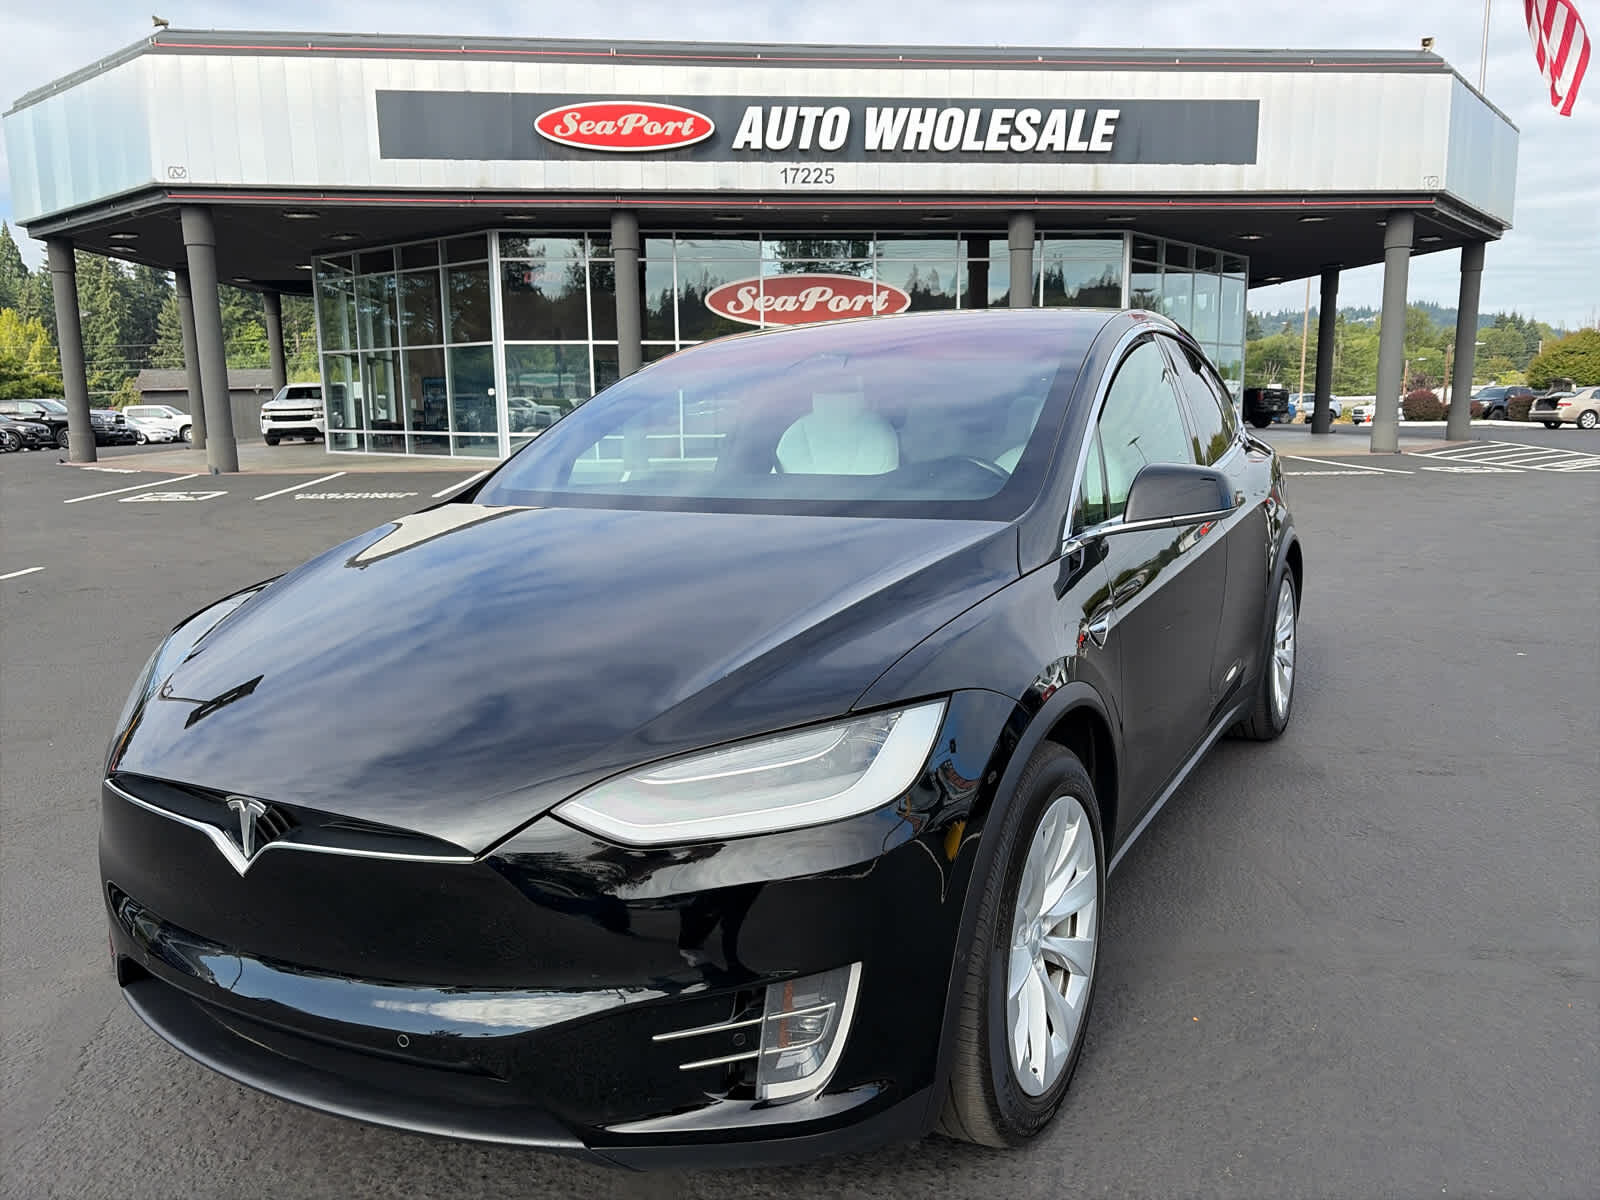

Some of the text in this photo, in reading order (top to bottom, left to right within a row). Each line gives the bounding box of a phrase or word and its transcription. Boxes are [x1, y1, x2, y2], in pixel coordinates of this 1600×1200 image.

[554, 111, 694, 137] SeaPort
[731, 106, 1120, 152] AUTO WHOLESALE
[780, 167, 835, 184] 17225
[727, 286, 889, 314] SeaPort
